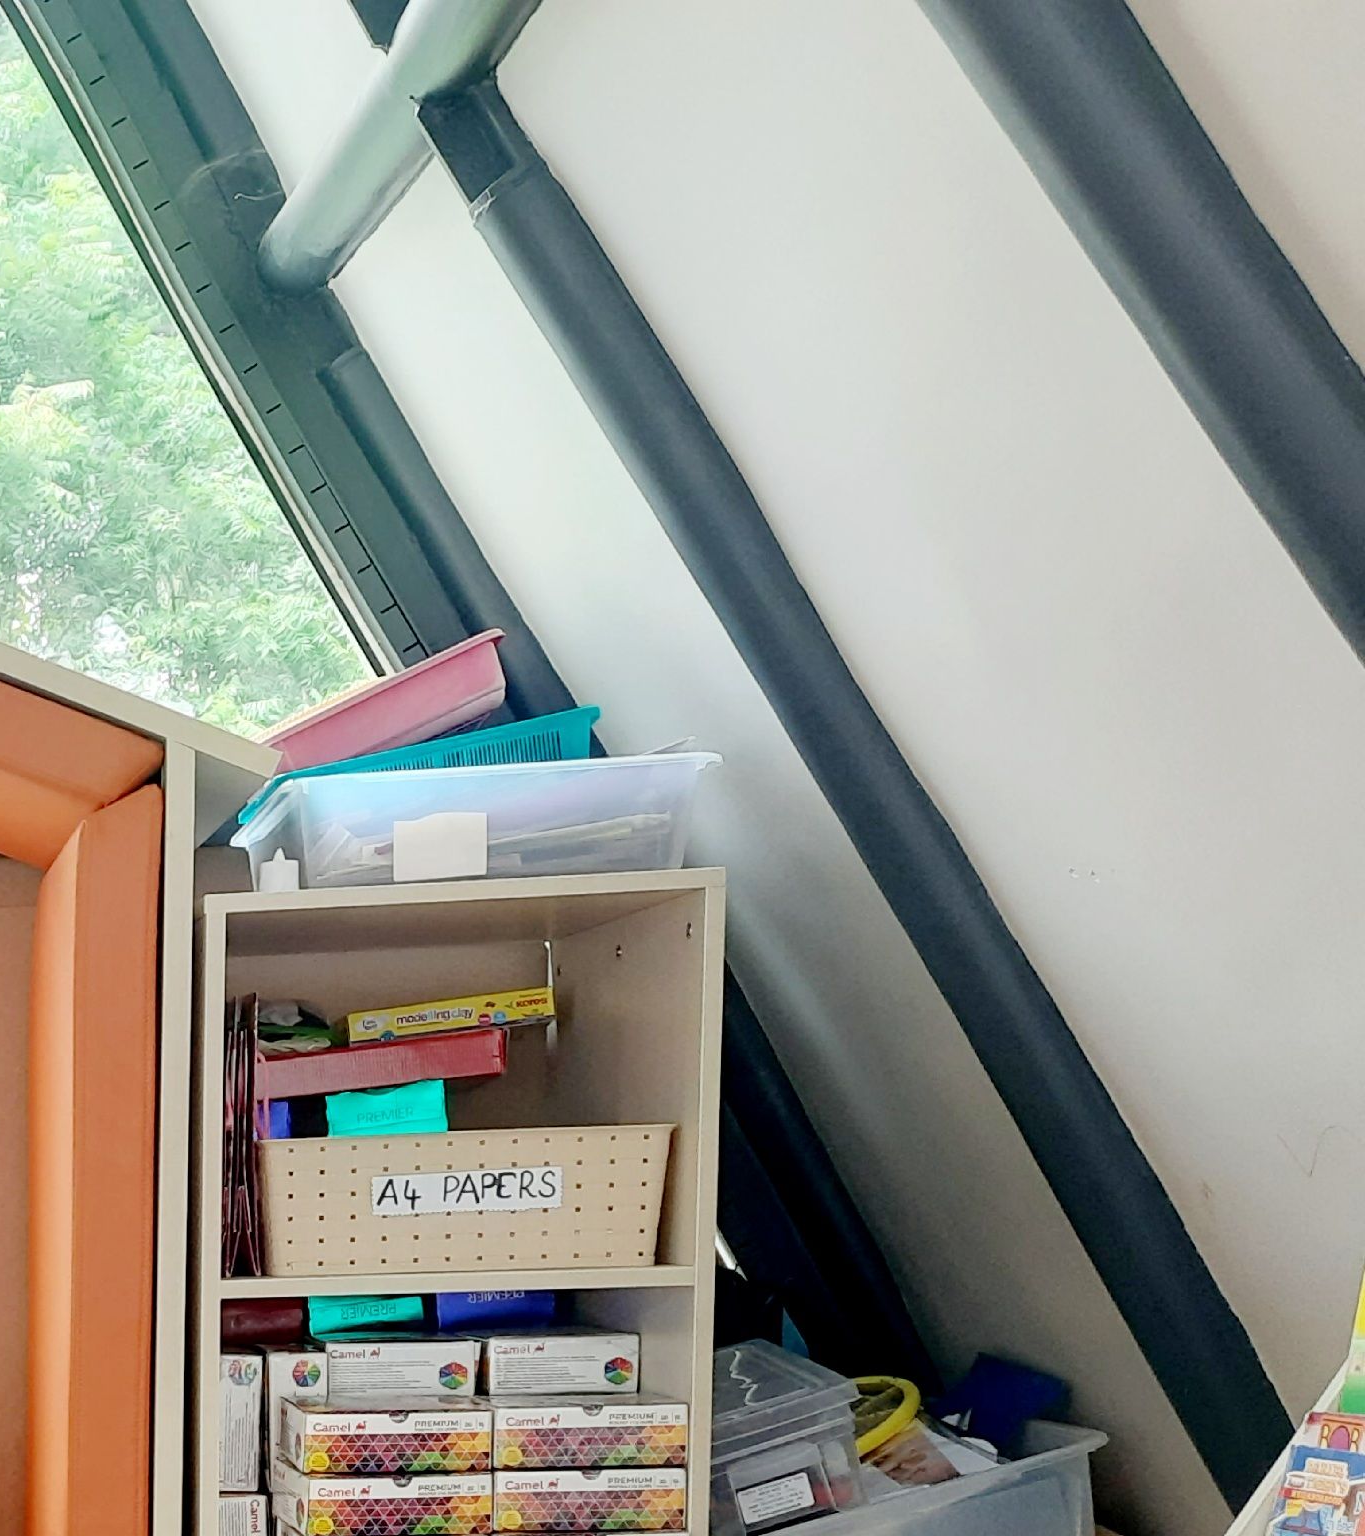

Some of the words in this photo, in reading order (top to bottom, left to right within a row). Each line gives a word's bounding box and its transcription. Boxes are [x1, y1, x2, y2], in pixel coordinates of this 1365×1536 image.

[357, 1106, 414, 1124] PREMIER
[377, 1178, 421, 1210] A4
[443, 1170, 556, 1204] PAPERS
[340, 1303, 396, 1321] PREMIER
[329, 1348, 367, 1360] Camel
[493, 1344, 531, 1356] Camel
[313, 1422, 351, 1433] Camel
[506, 1416, 545, 1427] Camel
[505, 1480, 544, 1491] Camel
[318, 1487, 356, 1498] Camel
[249, 1499, 261, 1534] Camel
